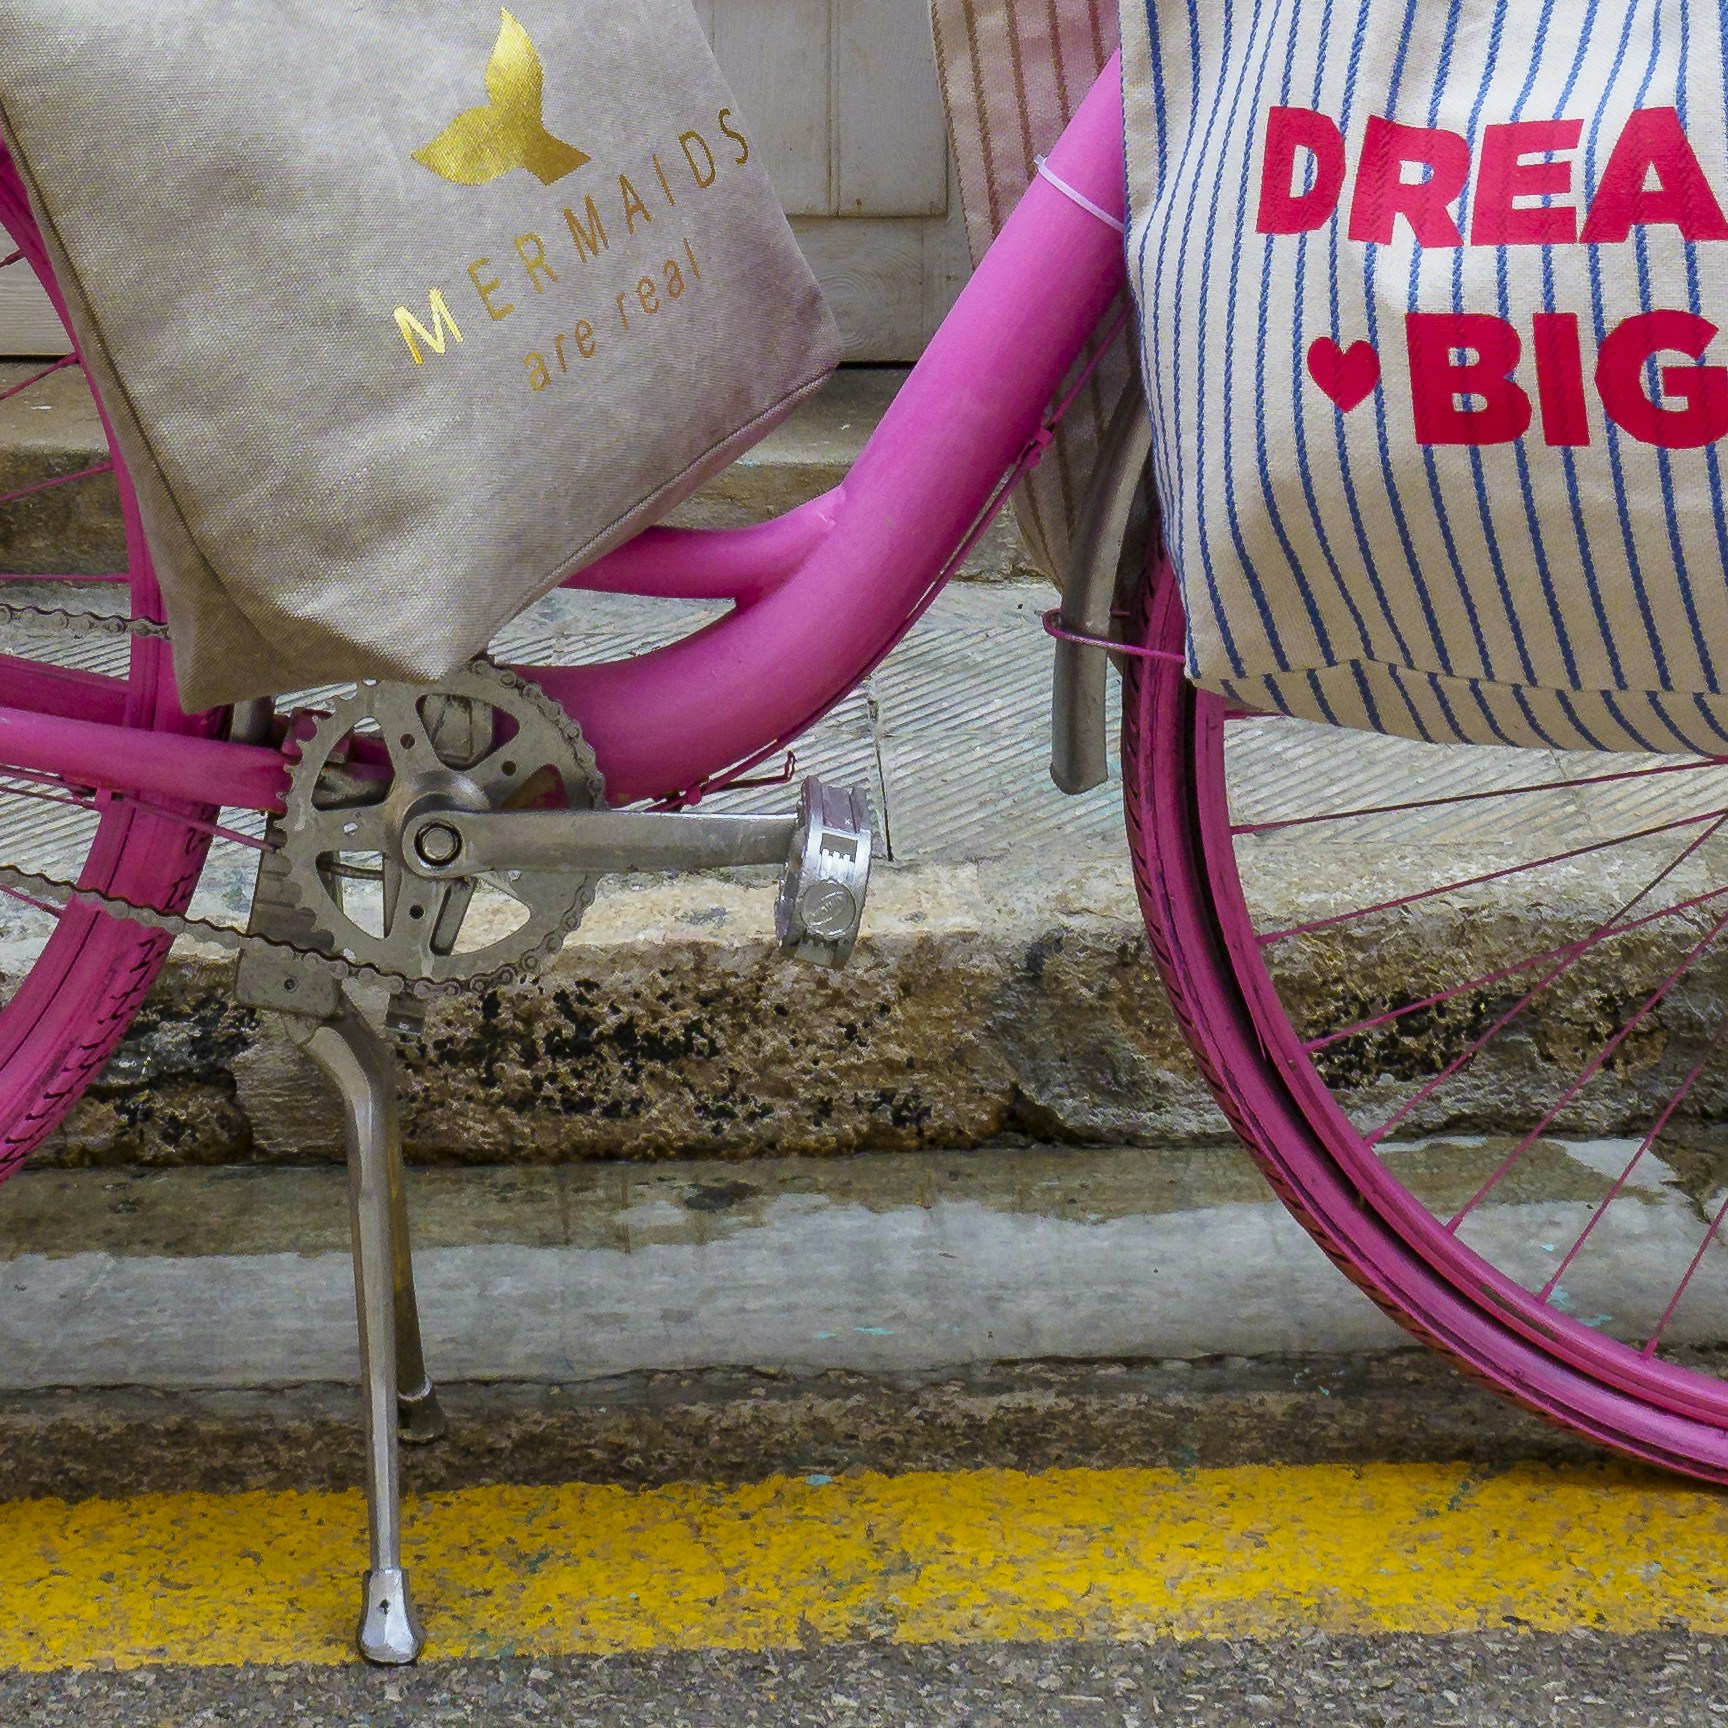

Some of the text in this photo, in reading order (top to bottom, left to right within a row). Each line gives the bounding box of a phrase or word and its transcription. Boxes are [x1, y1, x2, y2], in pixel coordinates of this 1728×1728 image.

[393, 107, 750, 365] MERMAIDS
[524, 238, 701, 392] are real
